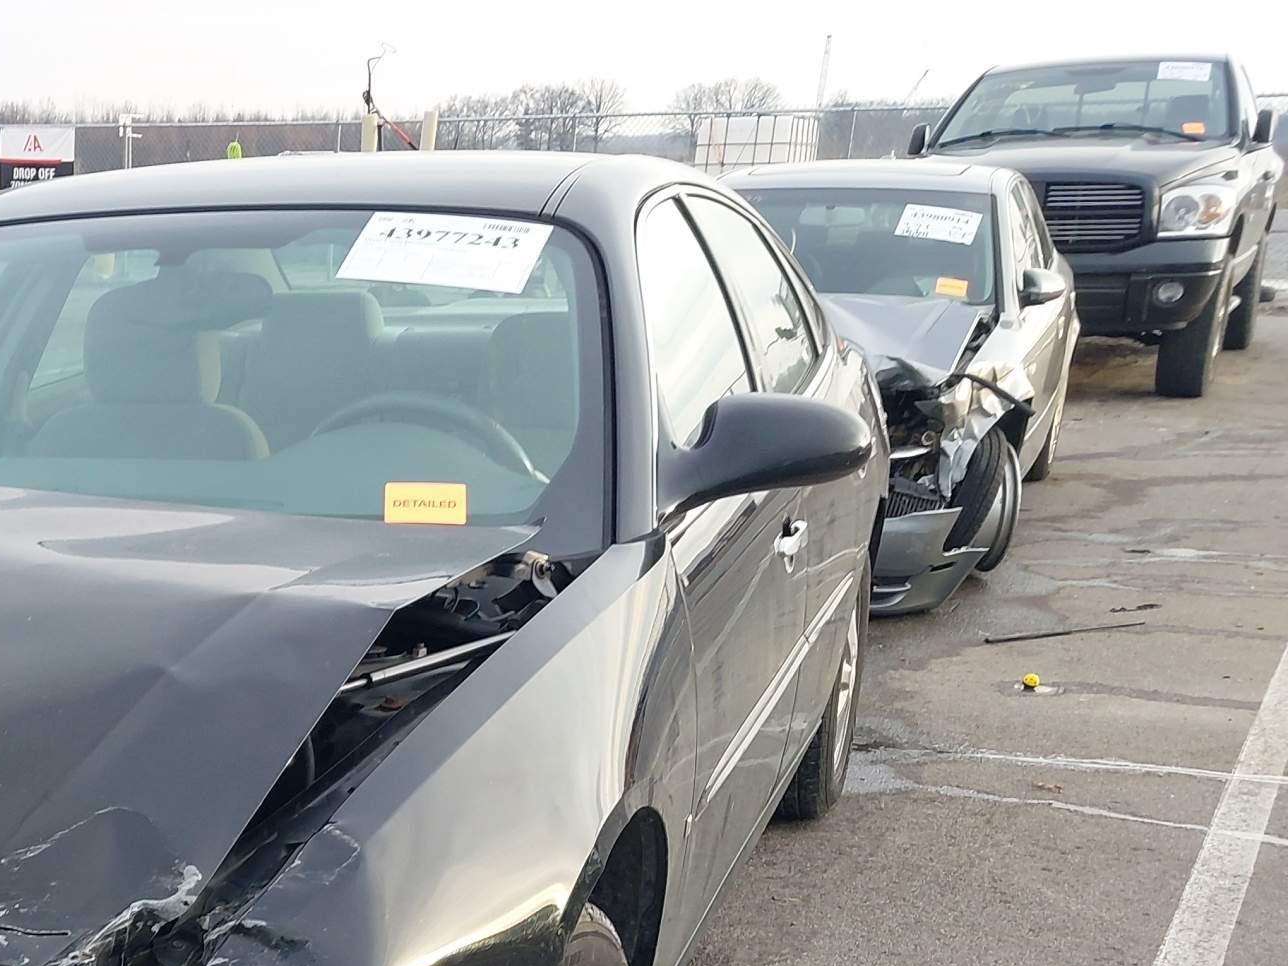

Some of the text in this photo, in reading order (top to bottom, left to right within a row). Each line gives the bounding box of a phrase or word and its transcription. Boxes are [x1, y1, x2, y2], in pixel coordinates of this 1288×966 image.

[13, 167, 56, 180] DROP OFF
[379, 227, 520, 250] 43977243
[392, 499, 457, 509] DETAILED
